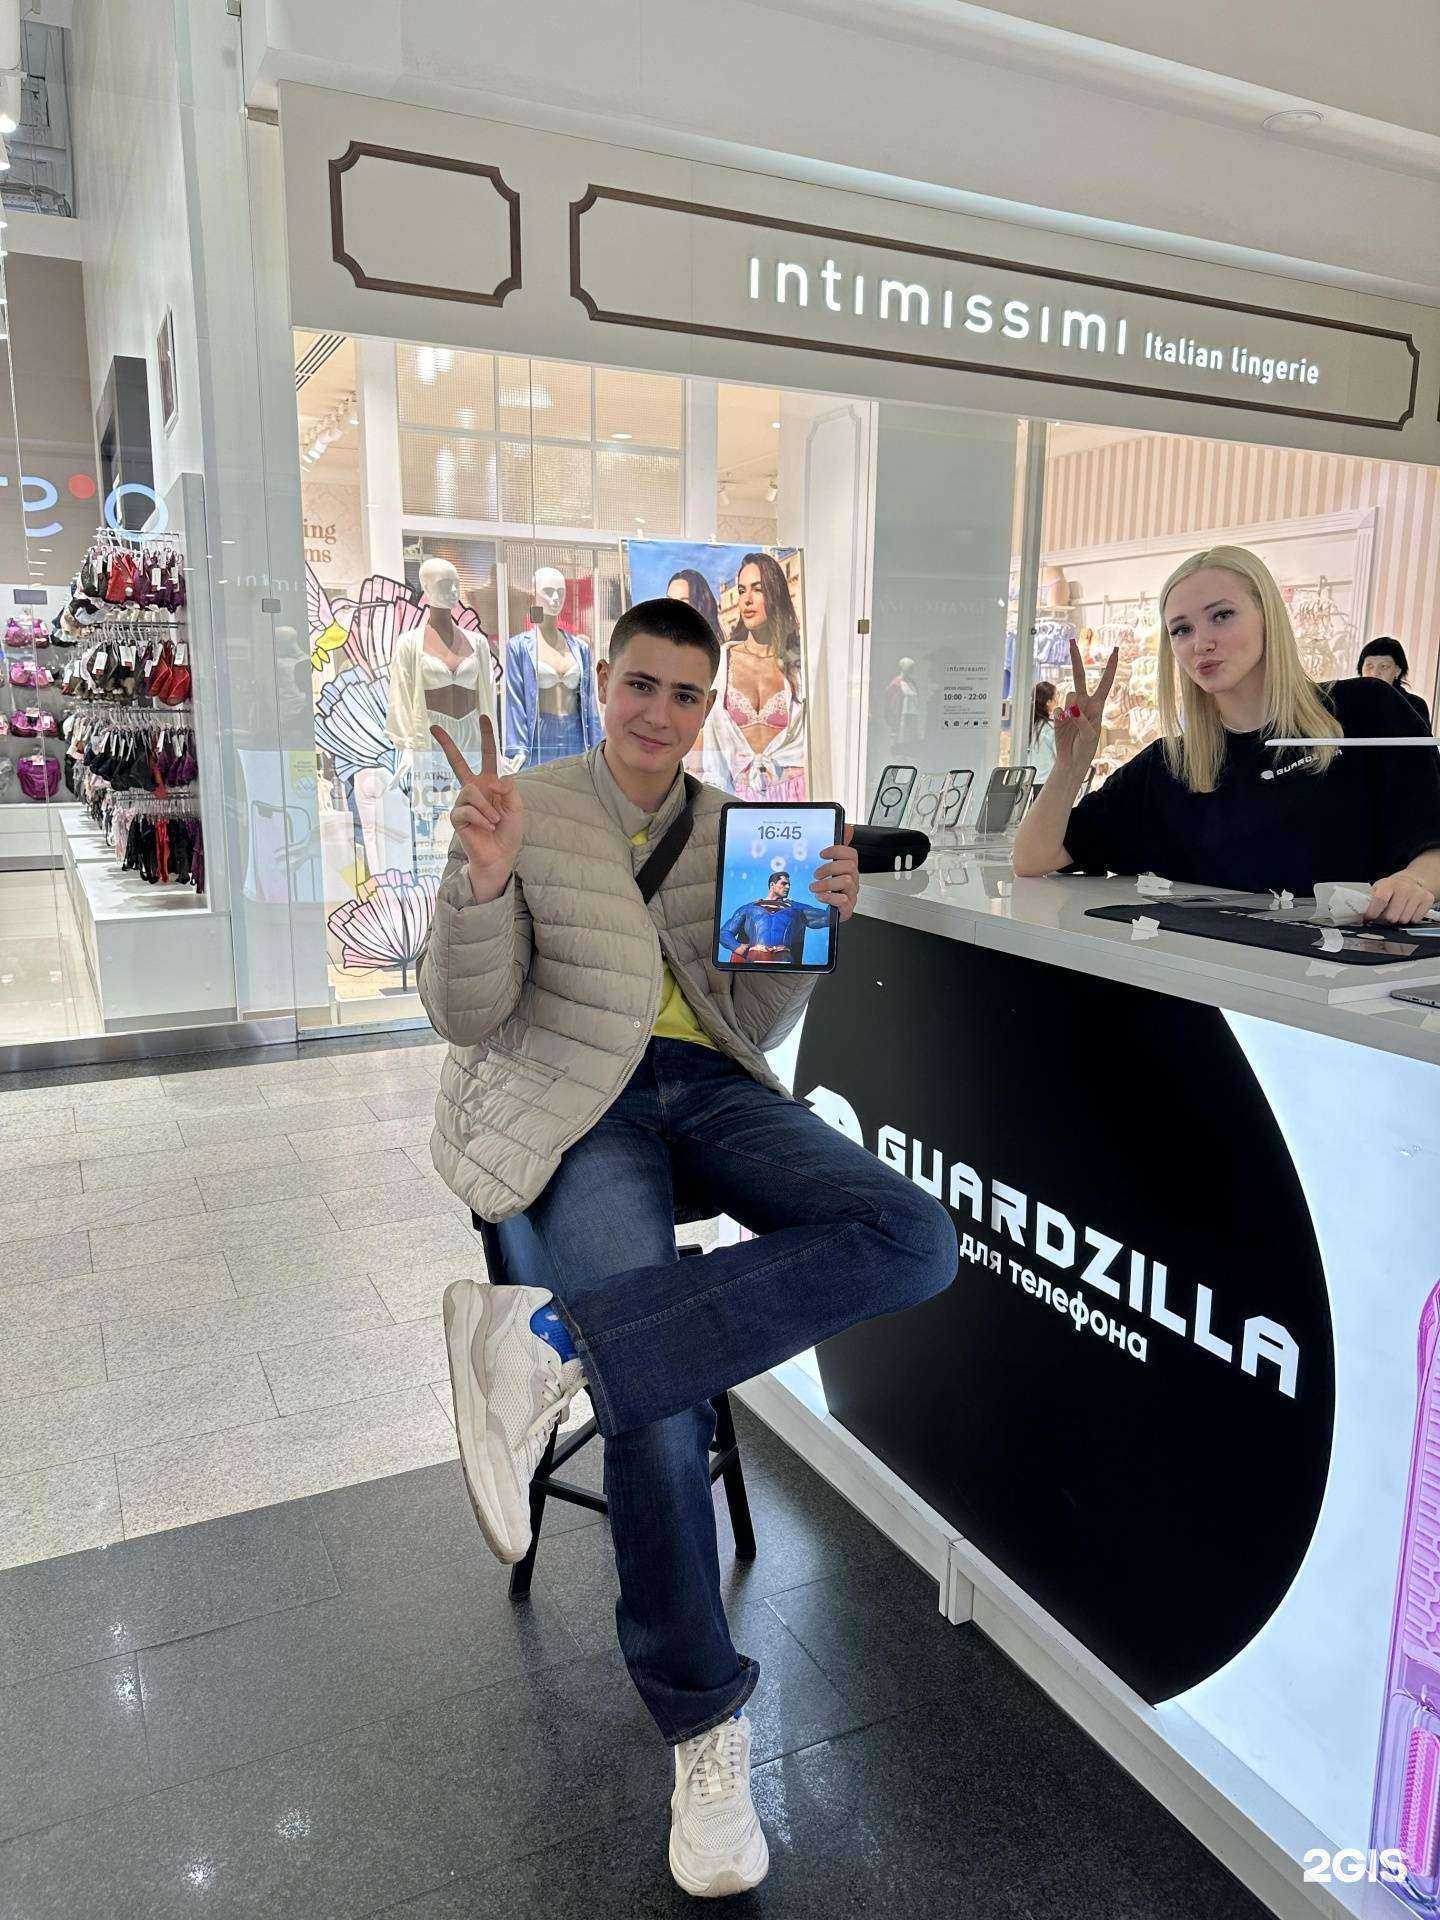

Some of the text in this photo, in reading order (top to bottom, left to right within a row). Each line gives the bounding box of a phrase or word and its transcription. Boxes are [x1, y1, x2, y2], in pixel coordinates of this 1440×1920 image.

[1145, 331, 1223, 370] Italian
[1231, 346, 1320, 385] lingerie
[944, 693, 962, 701] 10:00
[968, 693, 987, 701] 22:00
[758, 825, 802, 840] 16:45
[877, 1124, 1300, 1400] GUARDZILLA
[959, 1232, 1148, 1363] для телефона
